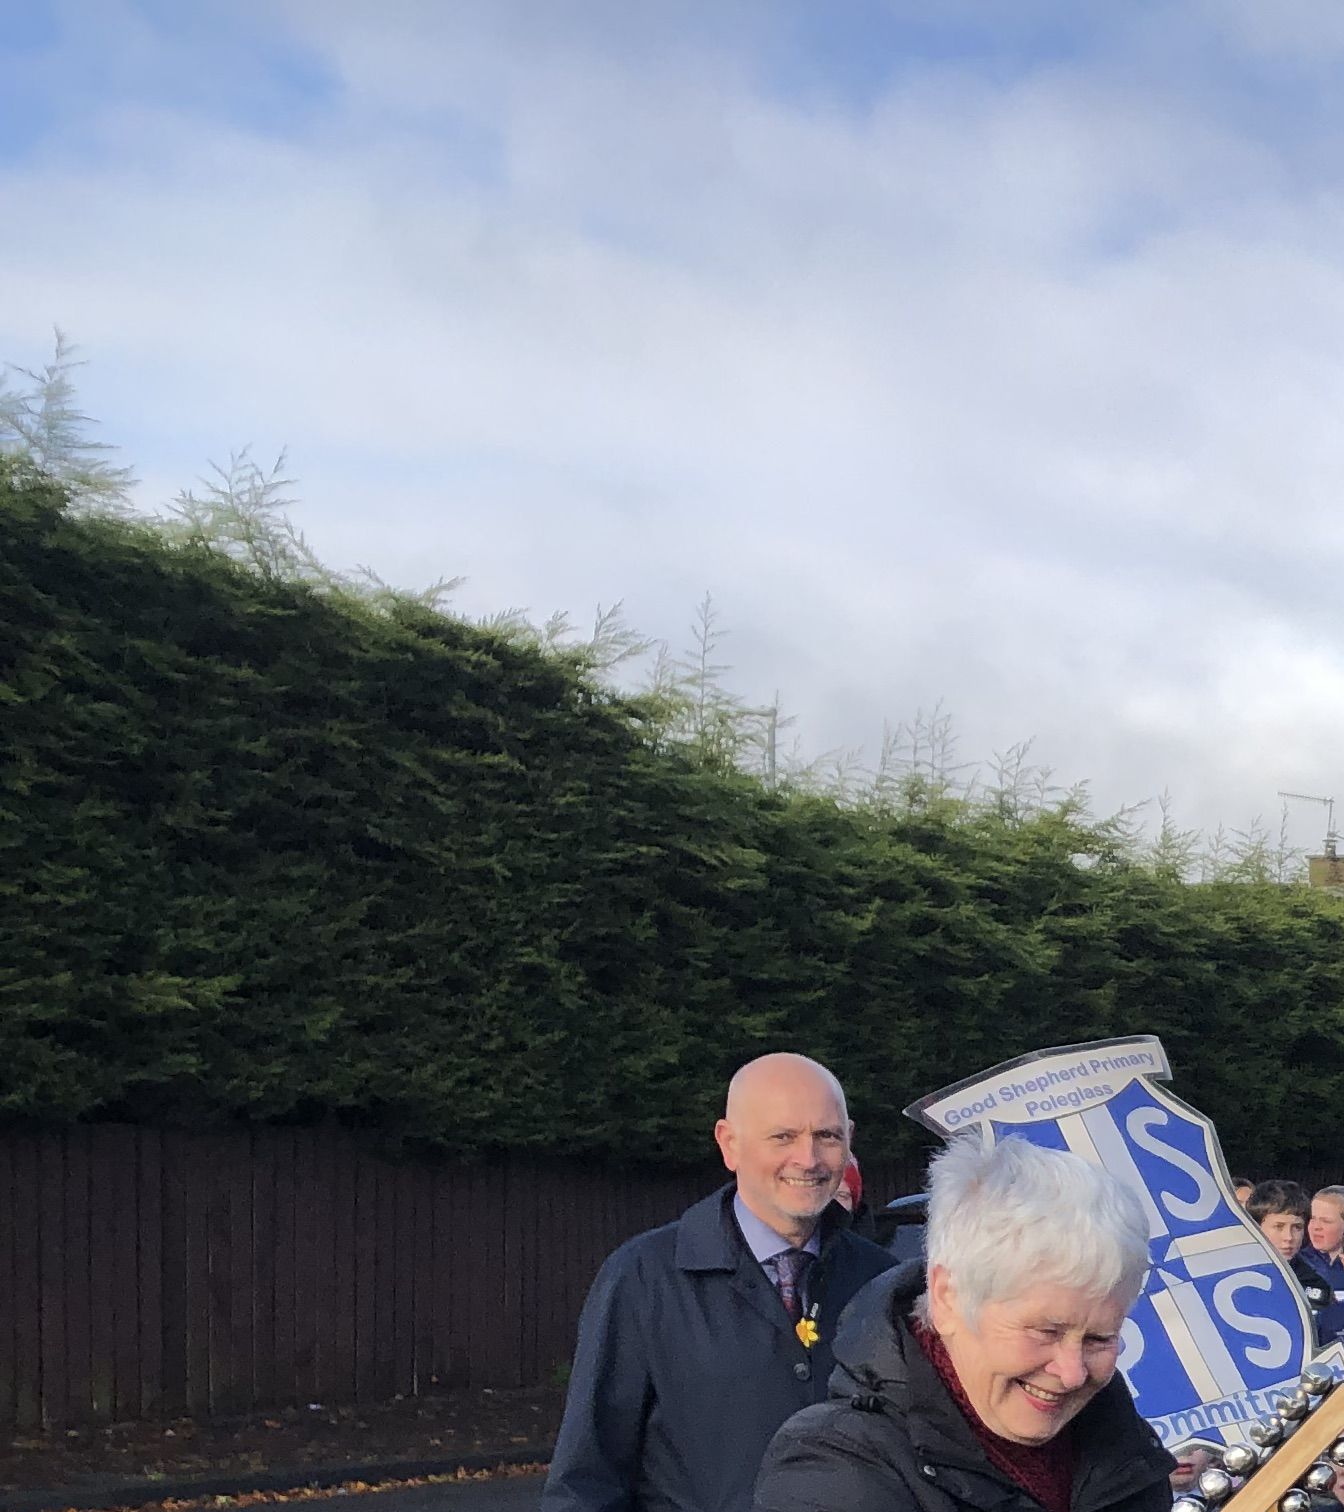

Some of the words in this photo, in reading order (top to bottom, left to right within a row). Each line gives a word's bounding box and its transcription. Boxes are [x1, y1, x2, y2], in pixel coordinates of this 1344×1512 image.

[943, 1092, 998, 1126] Good
[998, 1062, 1090, 1102] Shepherd
[1089, 1051, 1155, 1075] Primary
[1024, 1083, 1114, 1117] Poleglass
[1126, 1106, 1221, 1221] S
[1213, 1270, 1292, 1369] S
